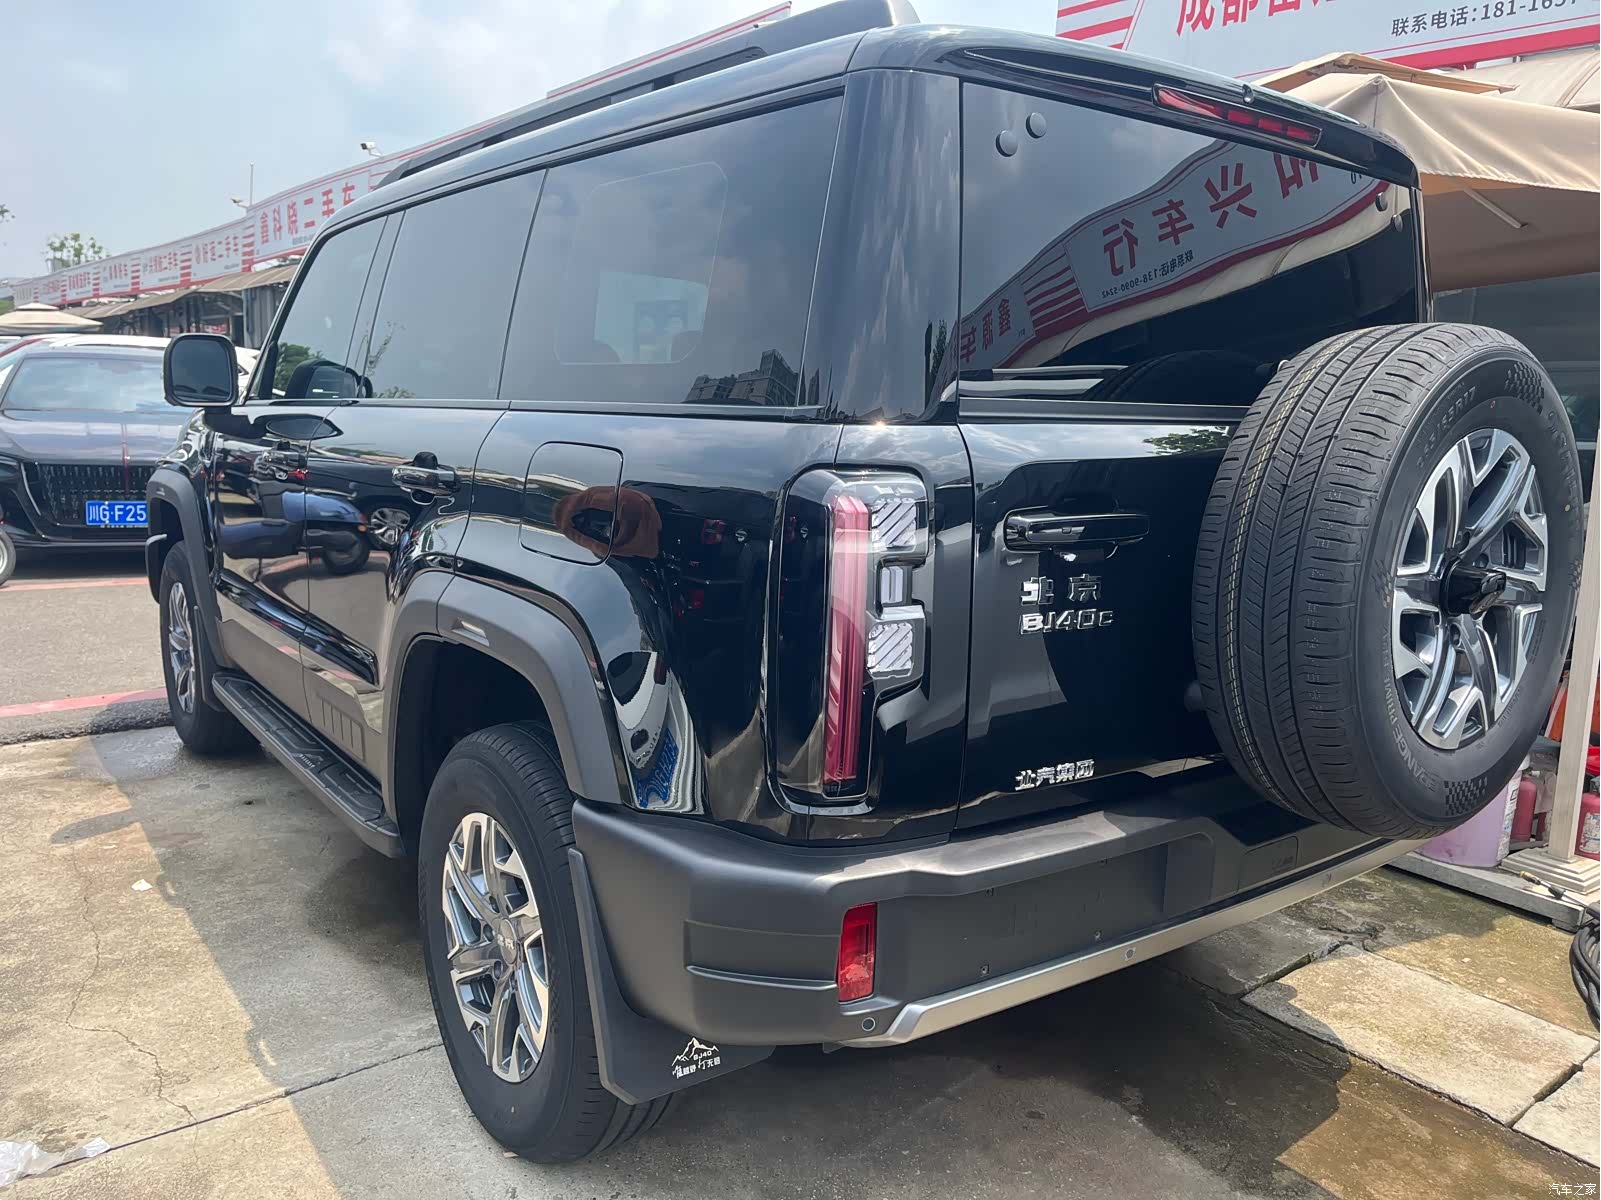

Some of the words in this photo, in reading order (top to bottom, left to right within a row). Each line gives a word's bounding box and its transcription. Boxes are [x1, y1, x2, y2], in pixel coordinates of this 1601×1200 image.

[1021, 573, 1102, 606] 北京
[1014, 758, 1095, 792] 北汽集团
[693, 1050, 713, 1061] BJ40
